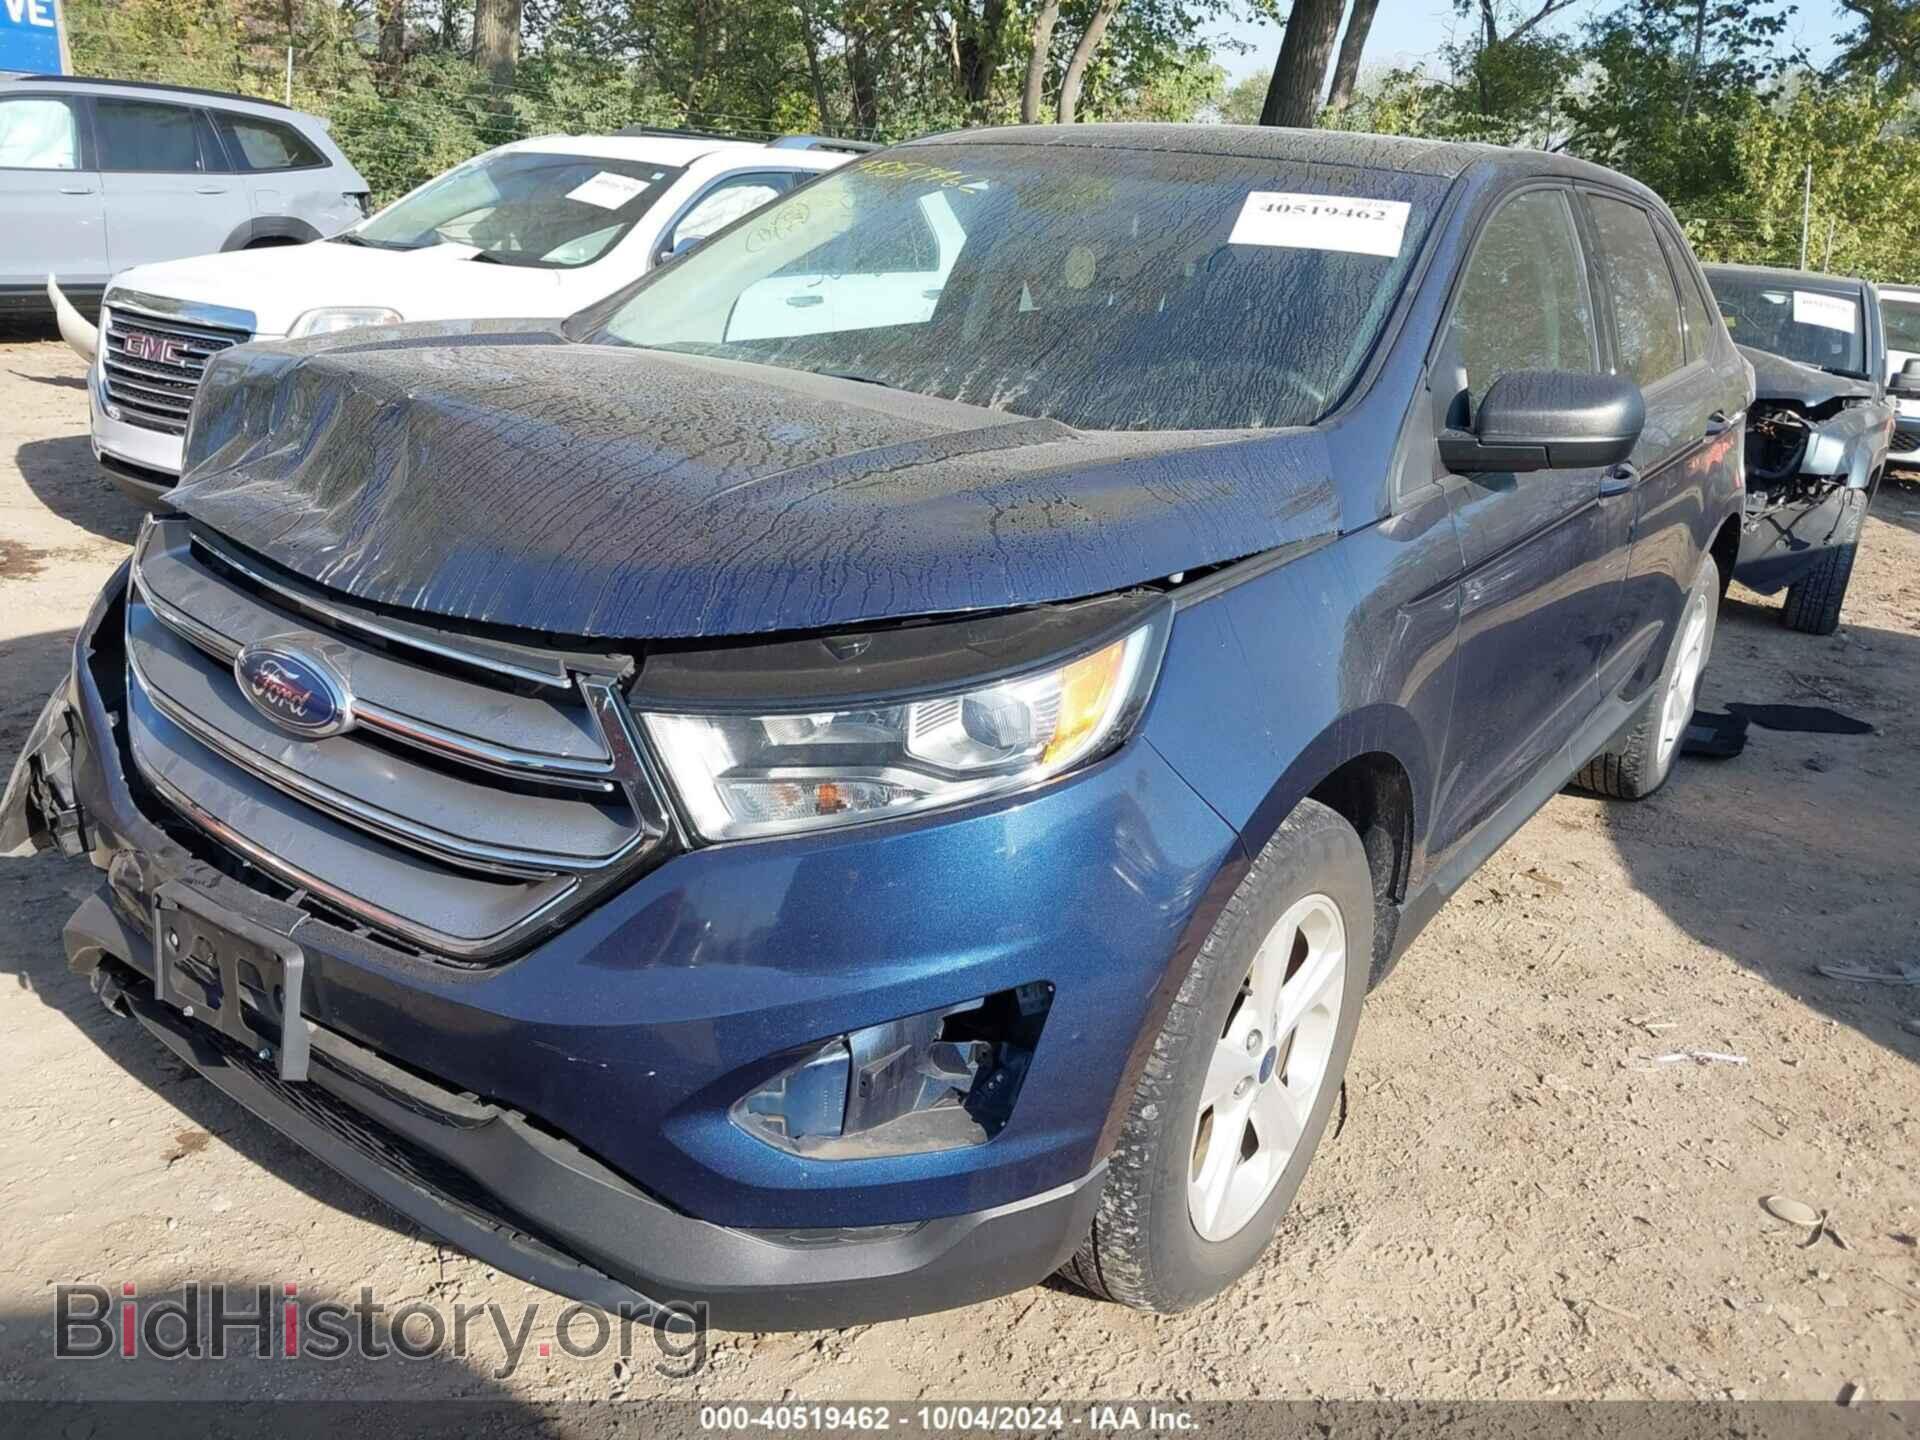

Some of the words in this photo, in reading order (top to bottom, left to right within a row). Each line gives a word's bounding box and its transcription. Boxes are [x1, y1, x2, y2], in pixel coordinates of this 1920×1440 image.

[1260, 203, 1386, 221] 40519462
[125, 334, 188, 367] GMC
[251, 659, 314, 717] Ford
